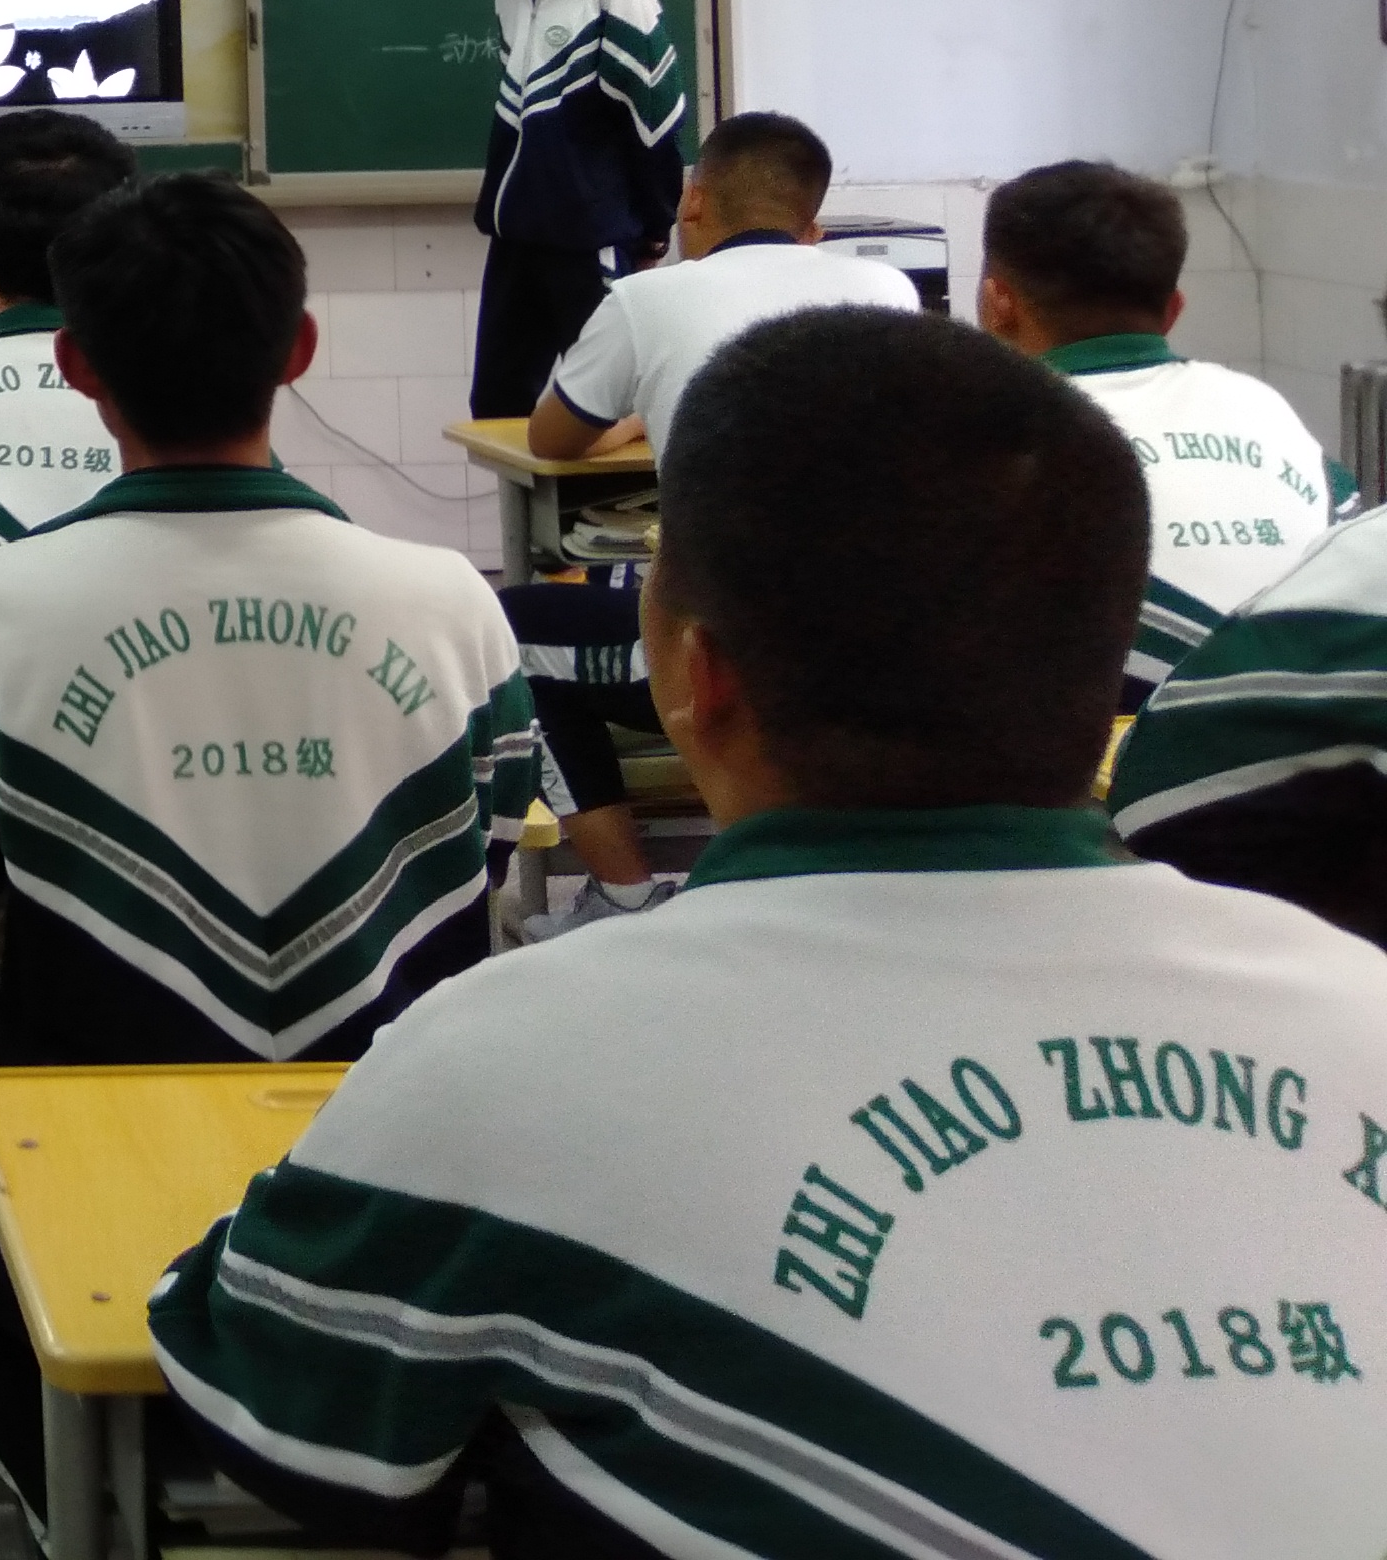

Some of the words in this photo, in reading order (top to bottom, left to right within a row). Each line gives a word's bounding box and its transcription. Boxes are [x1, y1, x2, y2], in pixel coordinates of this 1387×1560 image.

[1162, 431, 1263, 469] ZHONG
[1277, 457, 1319, 506] XIN
[1167, 518, 1285, 548] 2018级
[52, 664, 116, 747] ZHI
[104, 607, 191, 680] JIAO
[208, 596, 358, 657] ZHONG
[365, 637, 437, 717] XIN
[171, 736, 337, 780] 2018级
[773, 1162, 896, 1321] ZHI
[849, 1056, 1023, 1194] JIAO
[1037, 1034, 1309, 1151] ZHONG
[1038, 1298, 1363, 1390] 2018级
